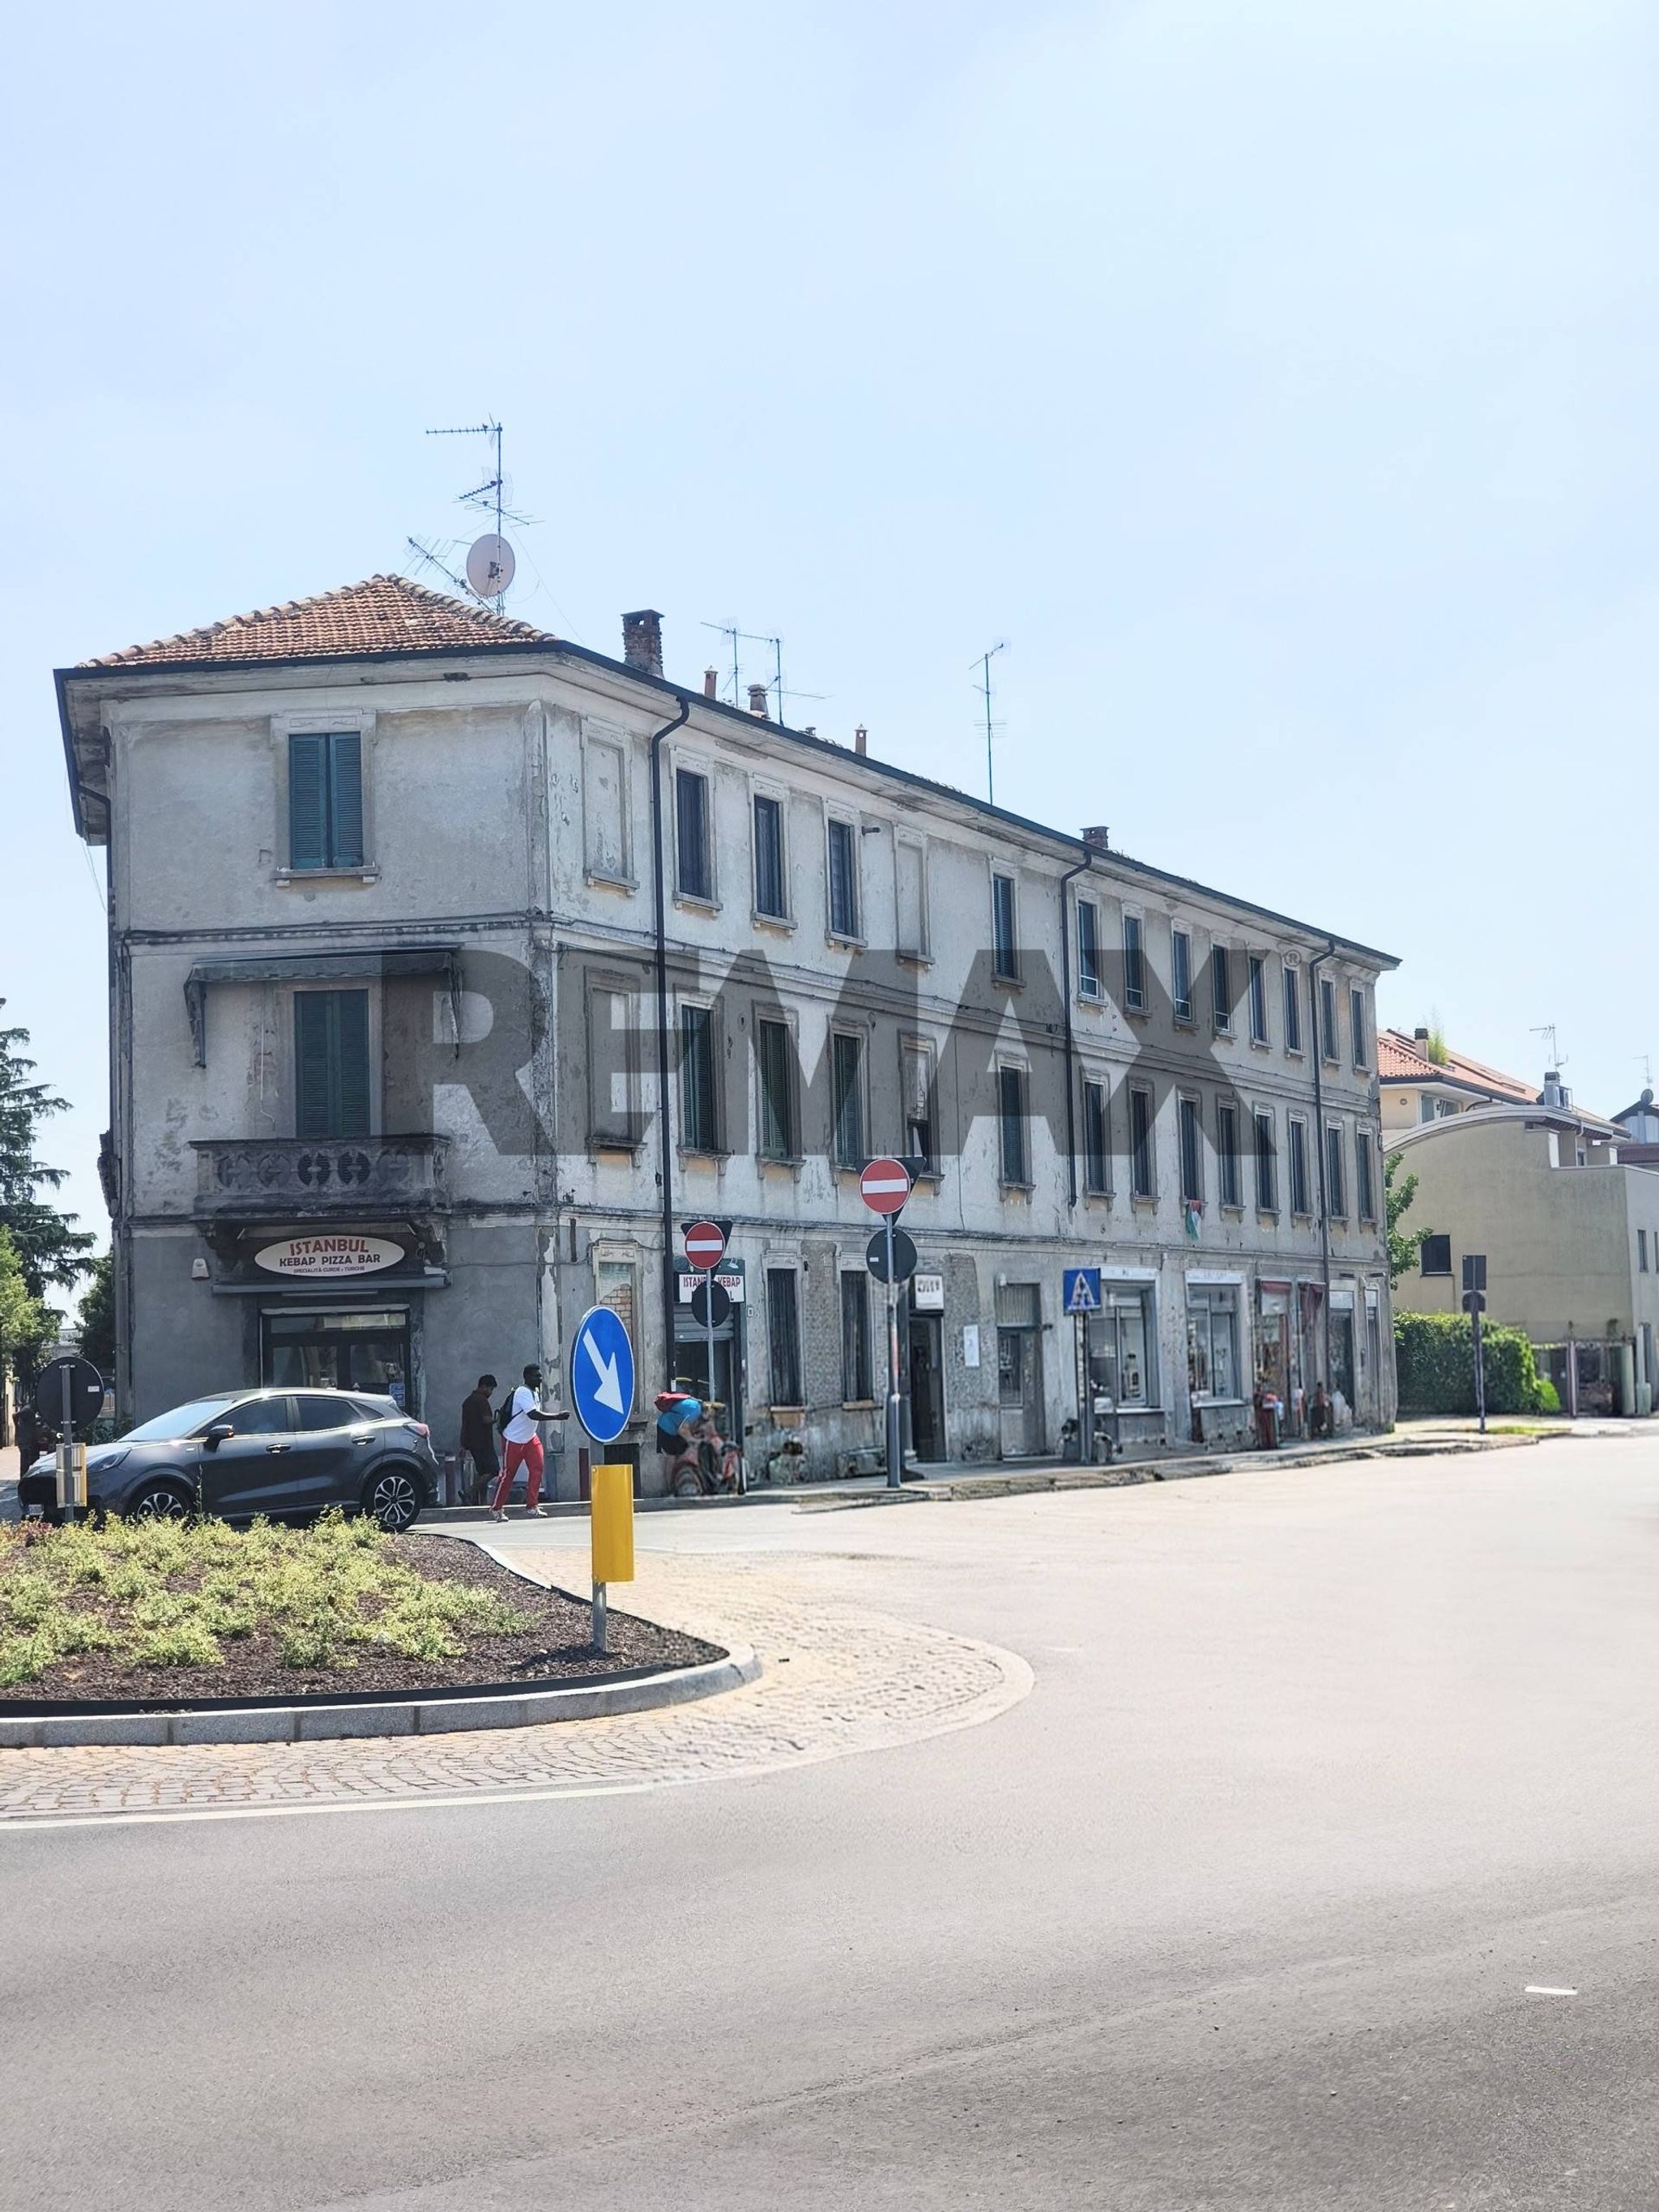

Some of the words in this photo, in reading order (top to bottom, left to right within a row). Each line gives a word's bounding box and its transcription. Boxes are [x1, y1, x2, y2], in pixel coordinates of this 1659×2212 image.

[290, 1238, 369, 1255] ISTANBUL
[279, 1256, 316, 1267] KEBAP
[322, 1255, 352, 1264] PIZZA
[358, 1254, 381, 1264] BAR
